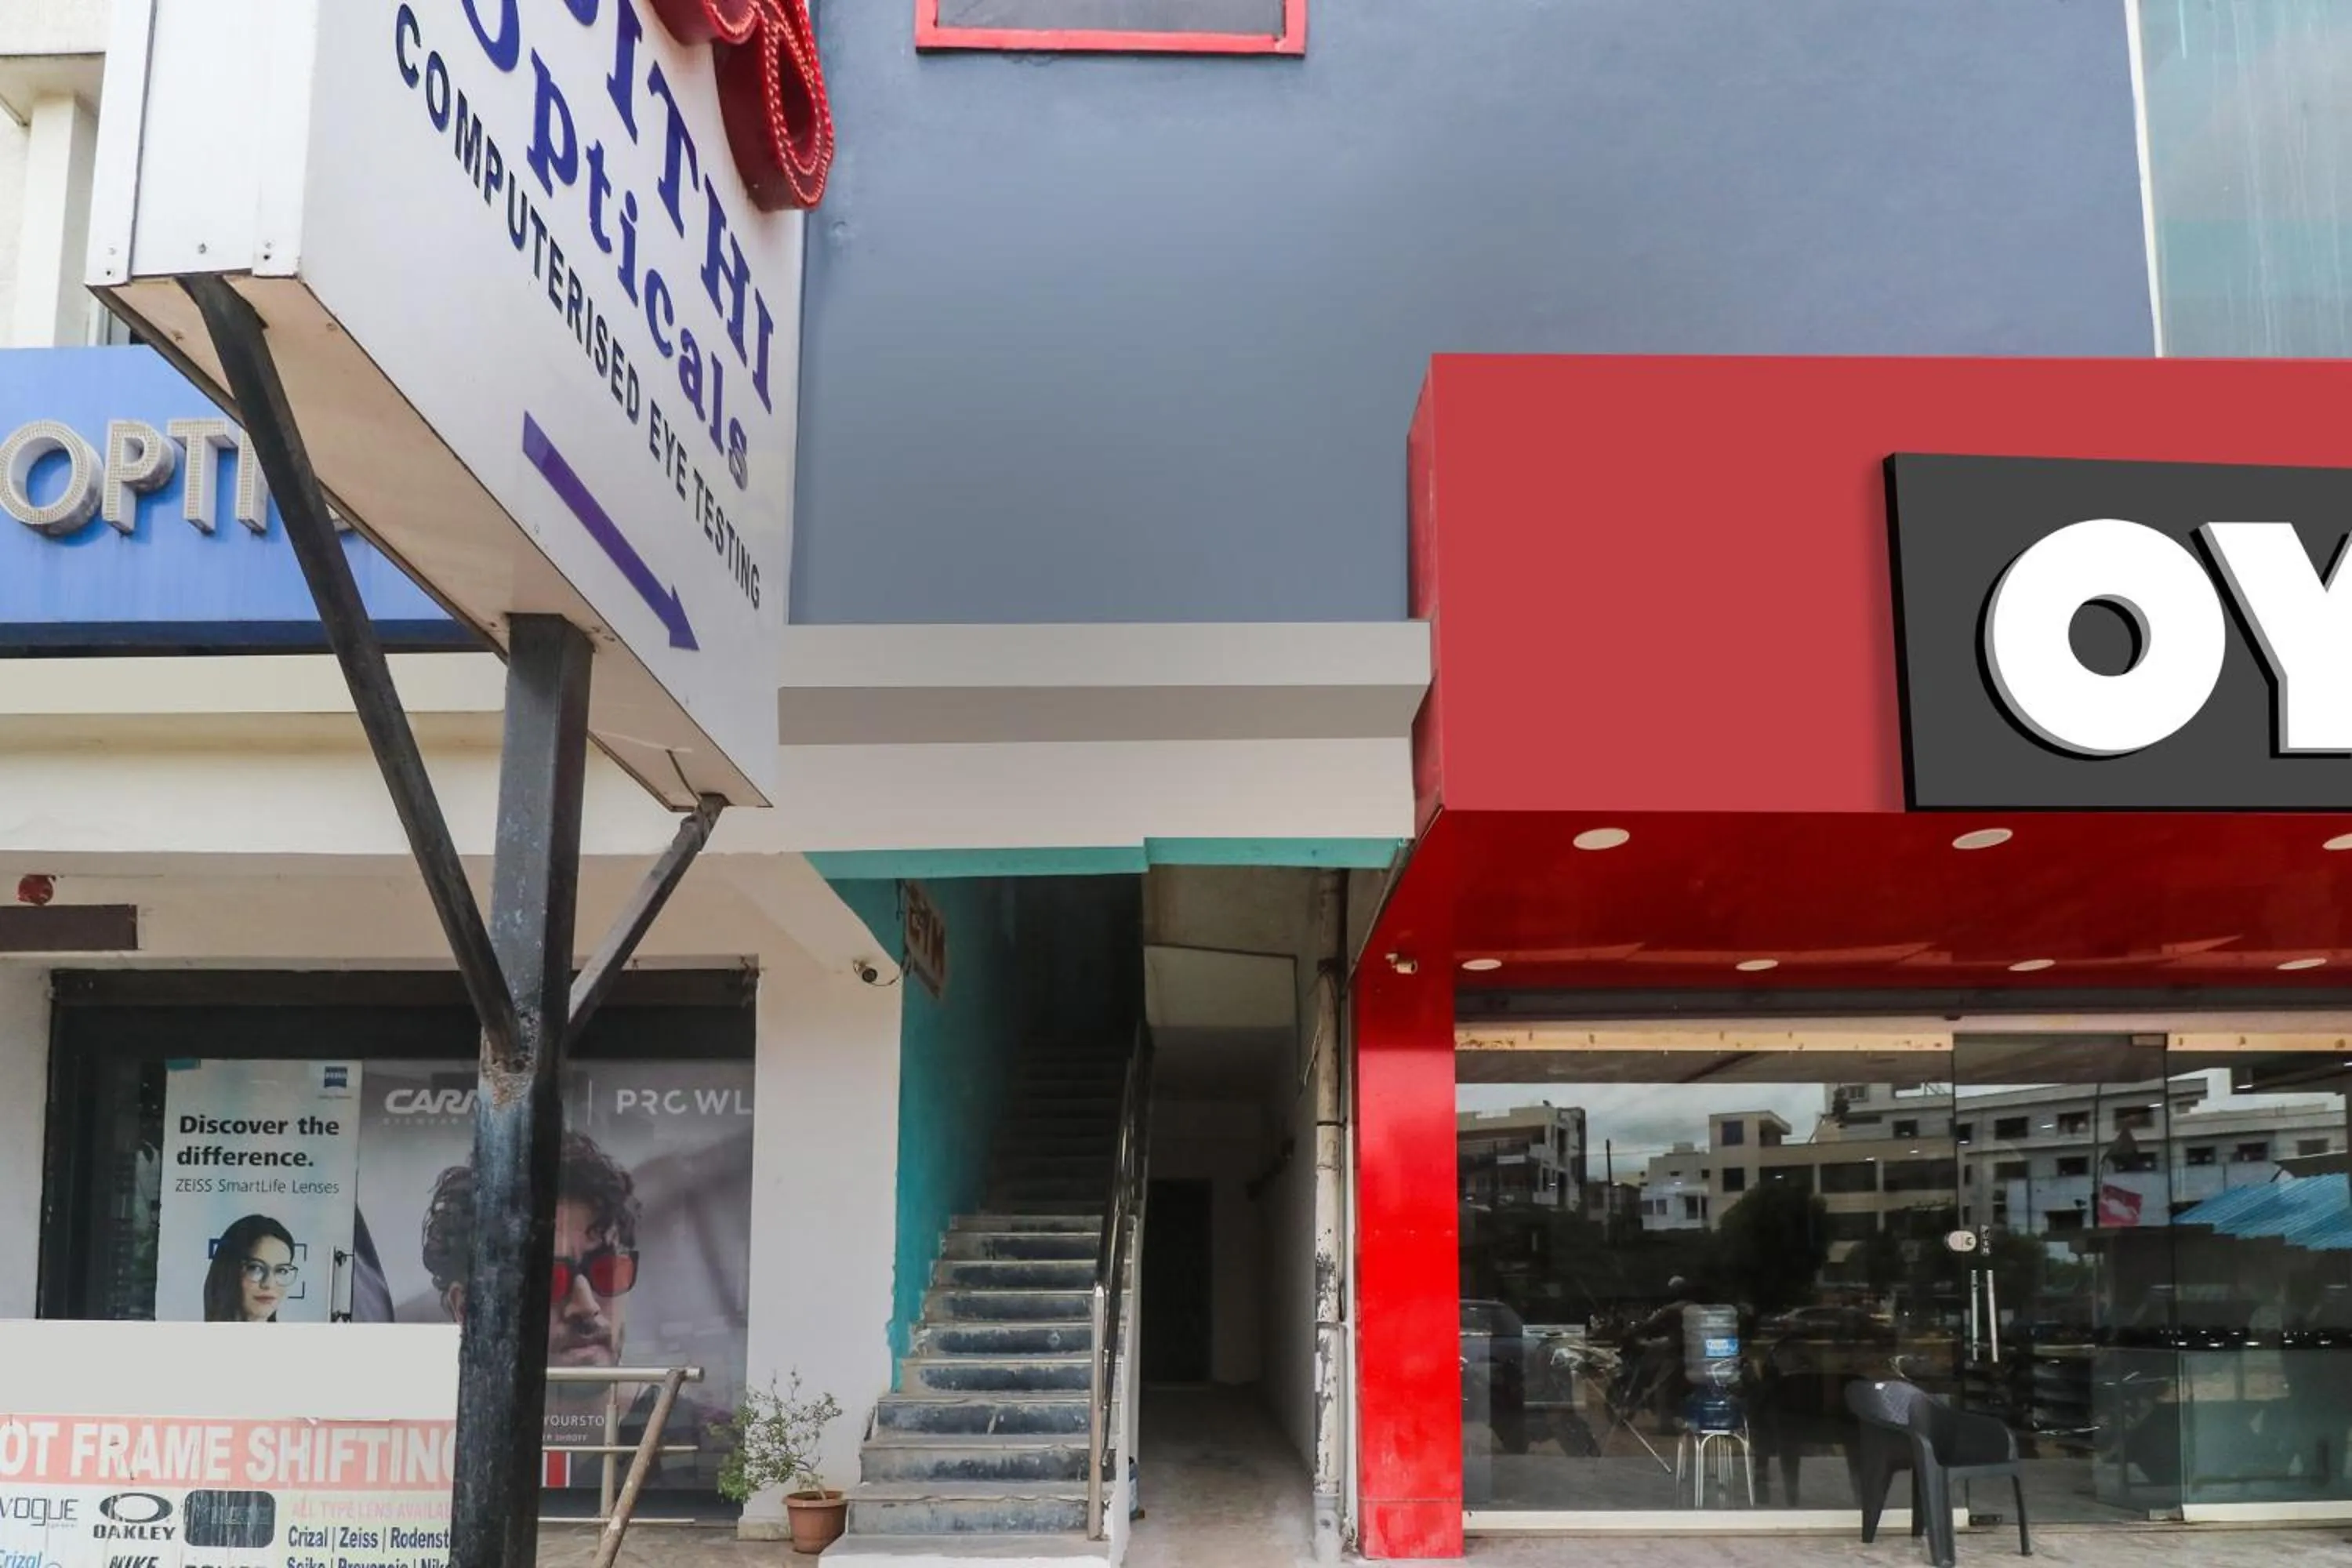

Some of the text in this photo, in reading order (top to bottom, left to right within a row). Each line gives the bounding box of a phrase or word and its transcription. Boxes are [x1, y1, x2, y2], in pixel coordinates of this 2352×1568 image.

[563, 0, 775, 417] ITHI
[395, 3, 760, 610] COMPUTERISED EYE TESTING
[0, 419, 353, 536] OPTI
[180, 1114, 339, 1135] Discover the
[176, 1145, 314, 1167] difference.
[175, 1178, 339, 1194] ZEISS SmartLife Lenses
[70, 1421, 233, 1482] FRAME
[93, 1524, 176, 1541] OAKLEY
[288, 1525, 328, 1548] Crizal
[339, 1526, 378, 1548] Zeiss
